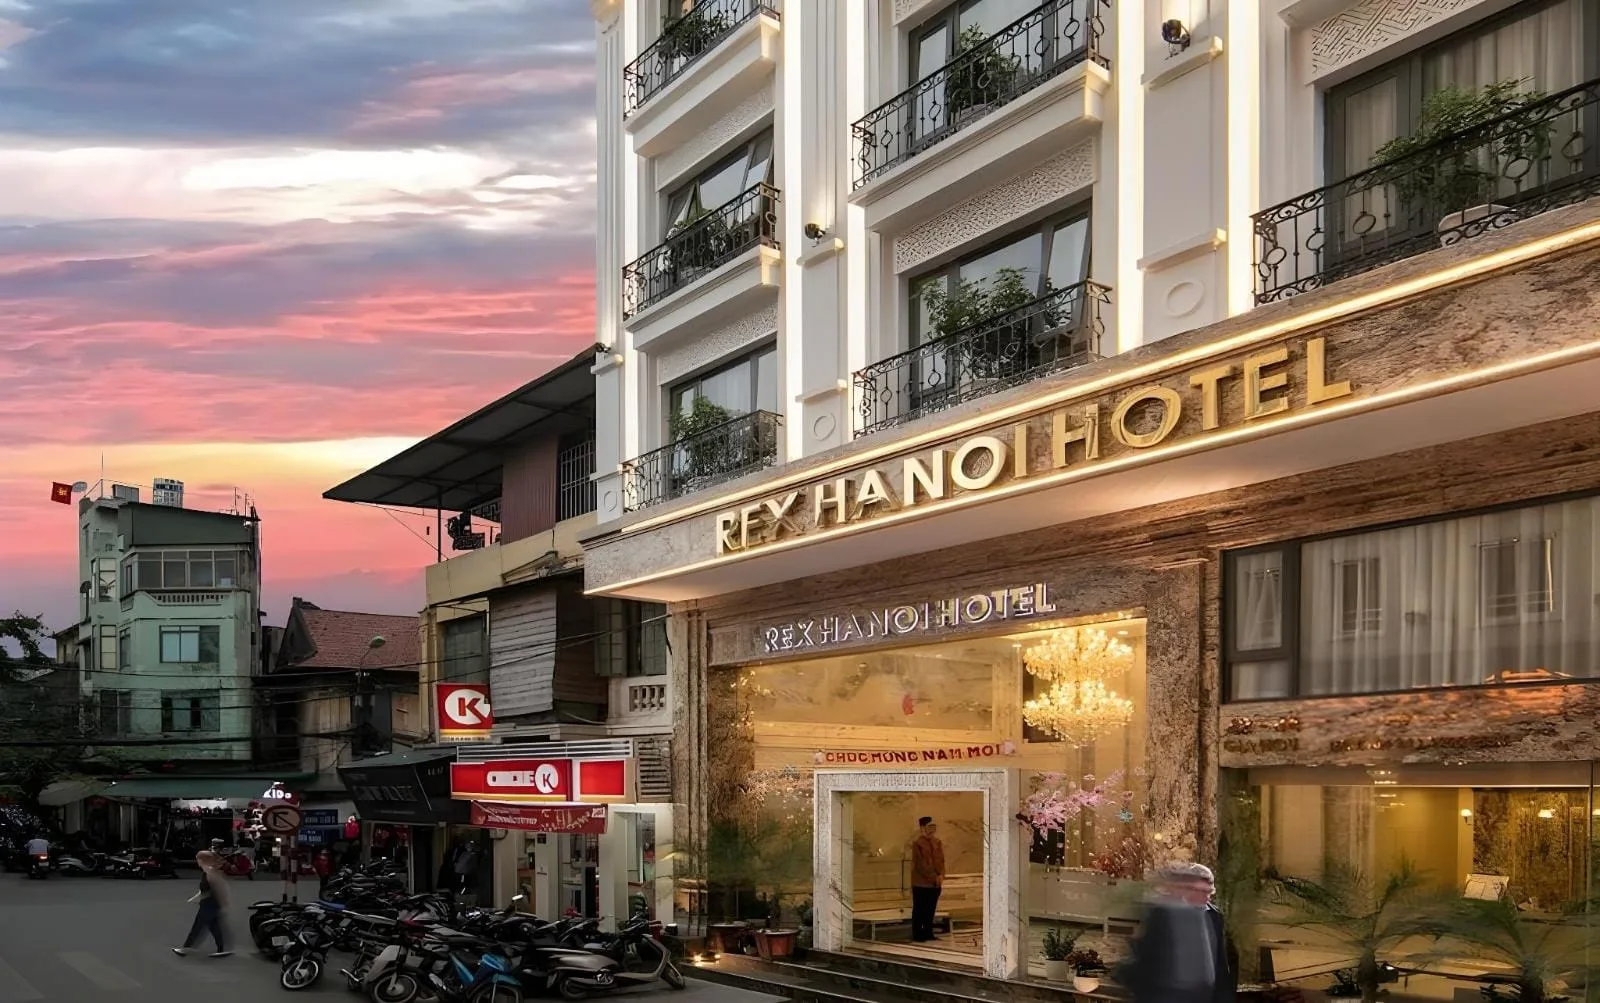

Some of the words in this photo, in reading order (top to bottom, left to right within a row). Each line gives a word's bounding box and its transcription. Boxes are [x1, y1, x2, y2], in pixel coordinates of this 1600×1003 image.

[716, 491, 805, 556] REX
[814, 422, 1028, 525] HANOI
[1052, 337, 1352, 468] HOTEL
[764, 618, 815, 653] REX
[819, 602, 930, 644] HANOI
[937, 582, 1057, 627] HOTEL
